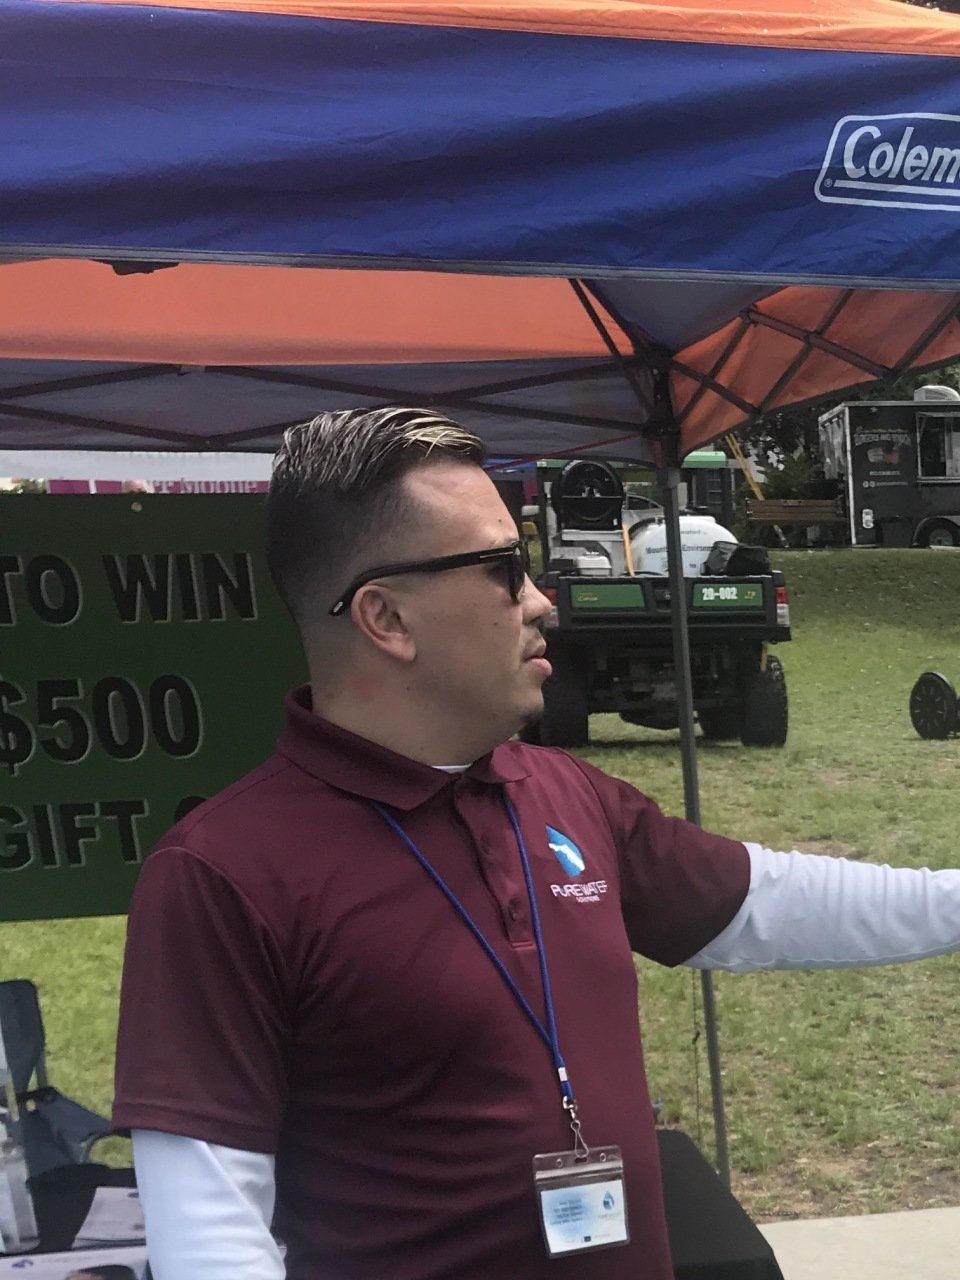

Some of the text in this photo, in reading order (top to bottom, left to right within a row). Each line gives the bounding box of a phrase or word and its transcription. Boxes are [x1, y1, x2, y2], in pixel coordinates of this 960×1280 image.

[102, 552, 258, 624] WIN
[0, 674, 203, 776] $500
[0, 800, 149, 871] GIFT
